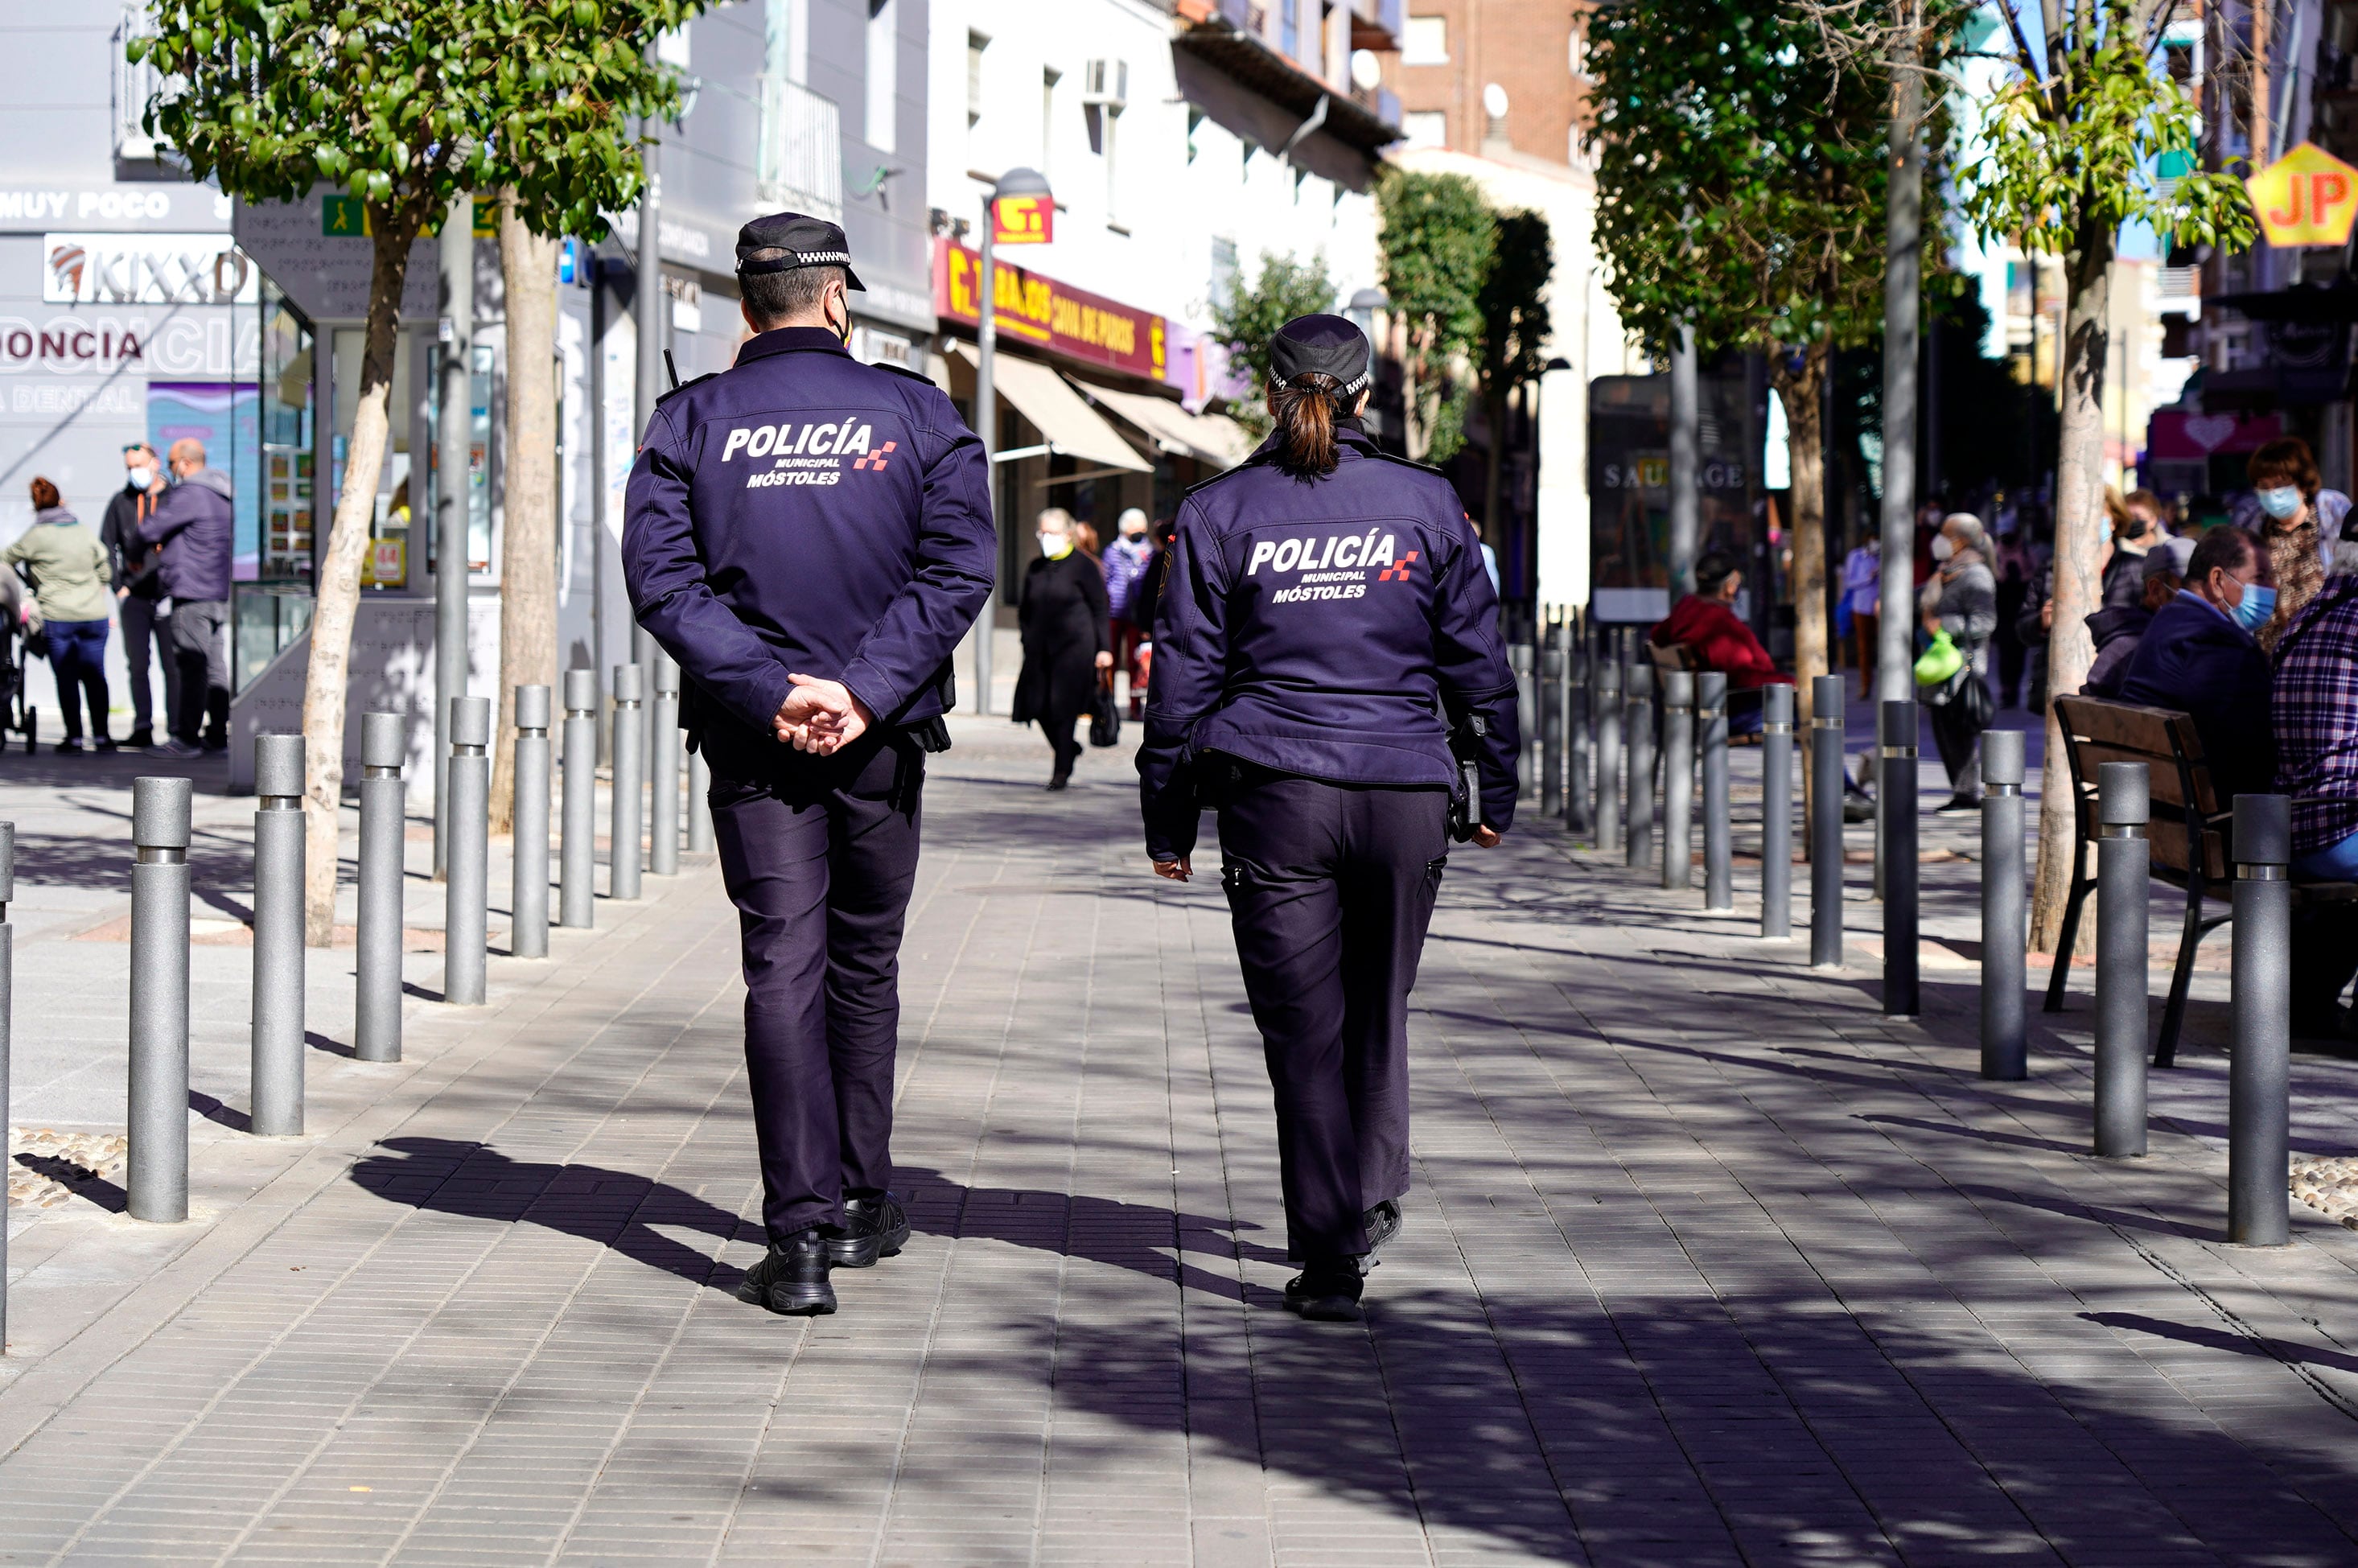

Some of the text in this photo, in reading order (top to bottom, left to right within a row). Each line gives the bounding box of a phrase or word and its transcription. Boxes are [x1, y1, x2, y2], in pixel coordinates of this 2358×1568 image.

[0, 192, 68, 219] MUY
[78, 191, 171, 219] POCO
[2269, 172, 2350, 226] JP
[0, 331, 142, 360] ONCIA
[13, 385, 140, 413] DENTAL
[722, 417, 871, 462] POLICÍA
[775, 458, 840, 468] MUNICIPAL
[1603, 463, 1745, 488] SAUGE
[747, 470, 840, 488] MÓSTOLES
[1247, 528, 1395, 576] POLICÍA
[1301, 570, 1366, 583] MUNICIPAL
[1272, 584, 1367, 603] MÓSTOLES
